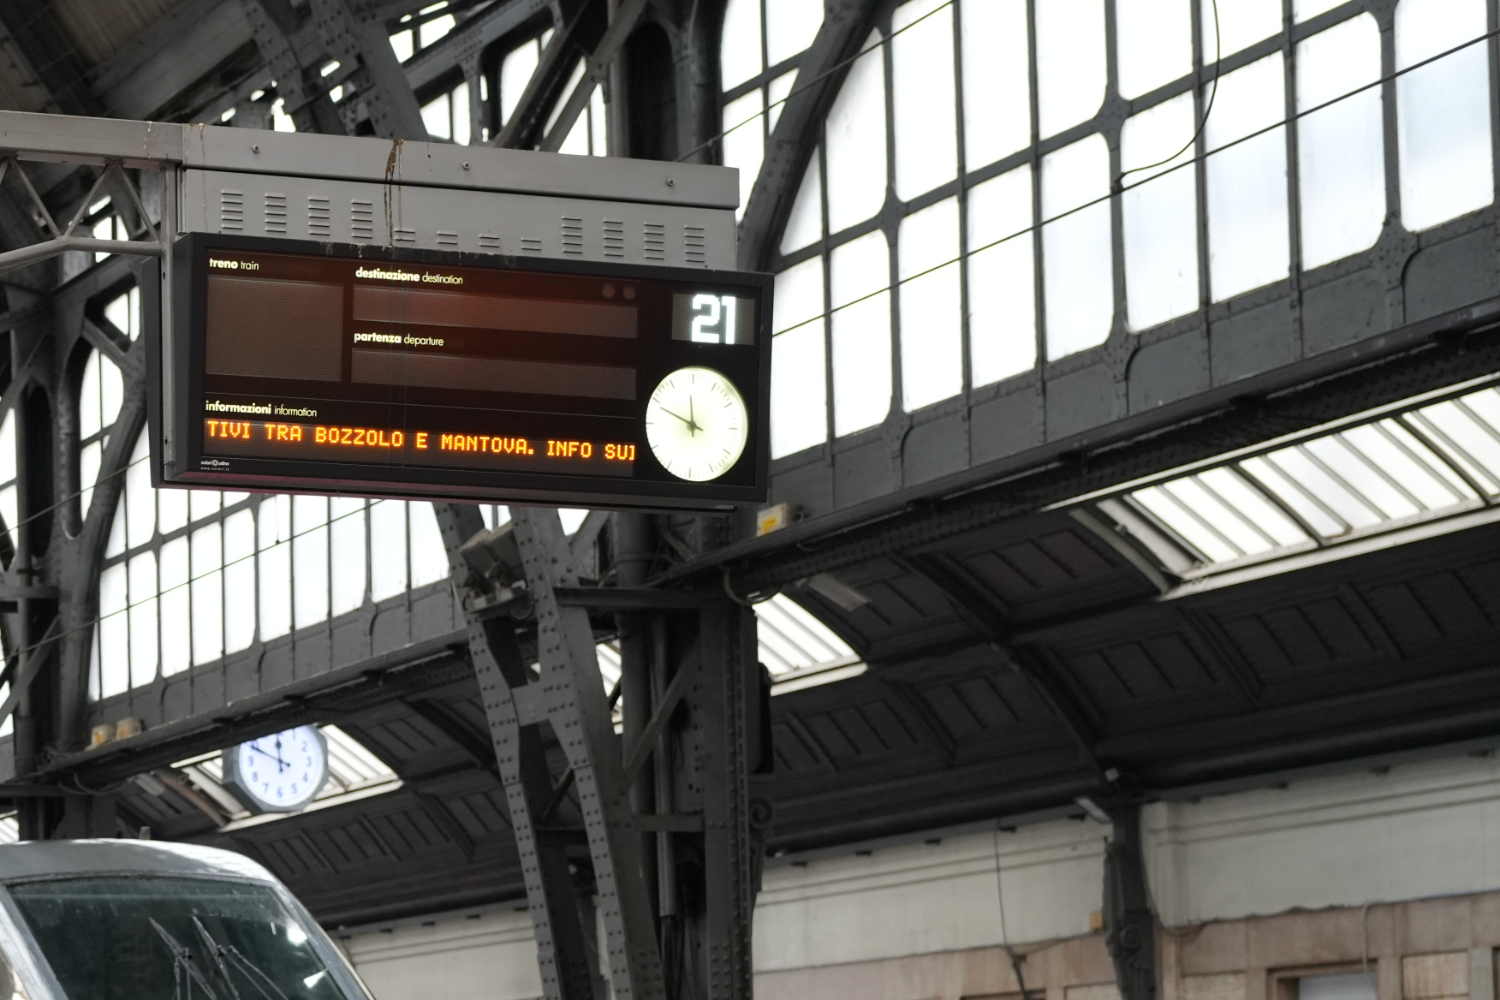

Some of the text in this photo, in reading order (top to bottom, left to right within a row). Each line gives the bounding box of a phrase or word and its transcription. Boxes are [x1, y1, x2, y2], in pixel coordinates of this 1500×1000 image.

[209, 258, 260, 271] treno train
[355, 267, 464, 285] destinazione destination
[691, 293, 736, 345] 21
[353, 332, 445, 347] partenza departure
[206, 400, 317, 417] informazioni information
[207, 419, 252, 440] TIVI
[264, 422, 304, 442] TRA
[314, 426, 404, 449] BOZZOLO
[415, 432, 429, 449] E
[440, 433, 535, 456] MANTOVA.
[546, 440, 593, 459] INFO
